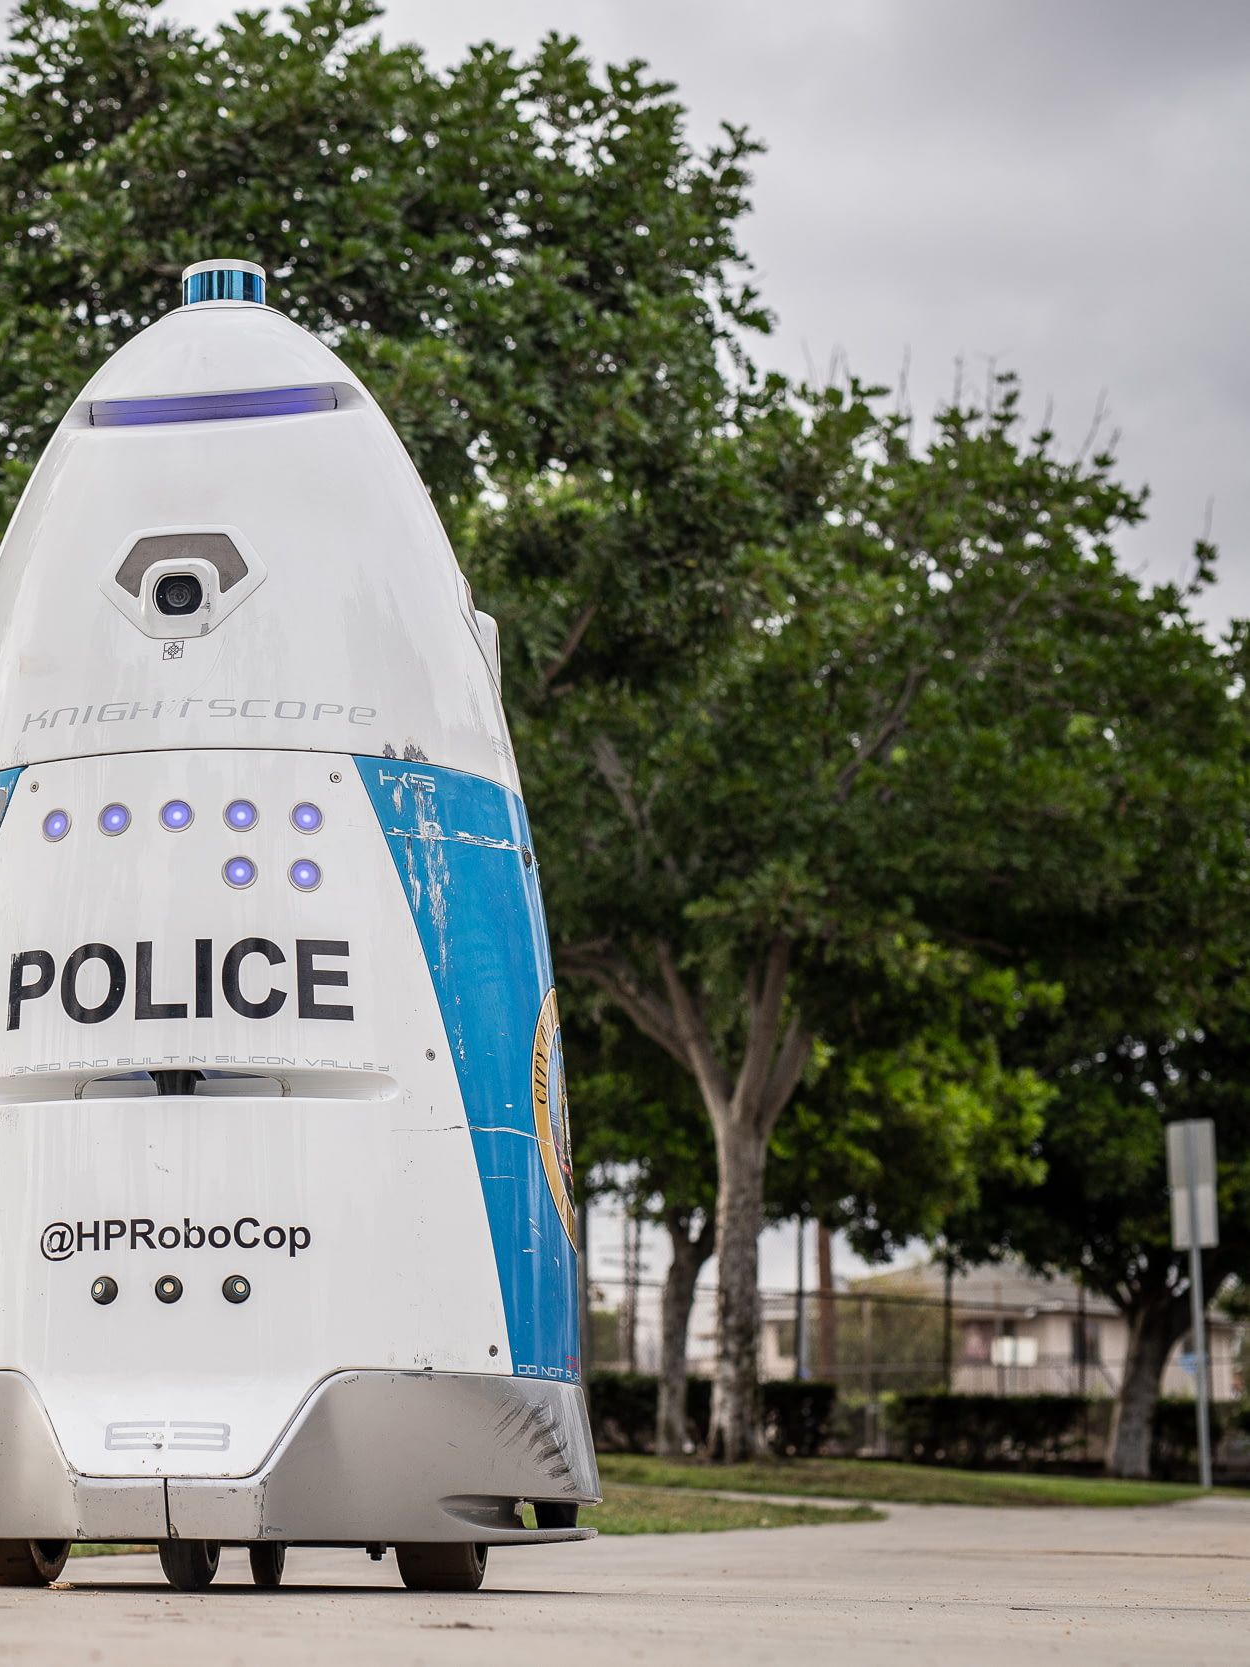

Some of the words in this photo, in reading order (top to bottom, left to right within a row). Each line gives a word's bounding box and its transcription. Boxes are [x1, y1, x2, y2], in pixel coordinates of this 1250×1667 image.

[6, 936, 354, 1031] POLICE
[68, 1059, 109, 1070] AND
[116, 1056, 179, 1066] BUILT
[188, 1055, 207, 1064] IN
[215, 1055, 295, 1066] SILICON
[305, 1058, 390, 1072] VALLEY
[535, 1044, 548, 1105] CITY
[40, 1217, 311, 1262] @HPRoboCop
[517, 1364, 538, 1375] DO
[541, 1366, 564, 1378] NOT
